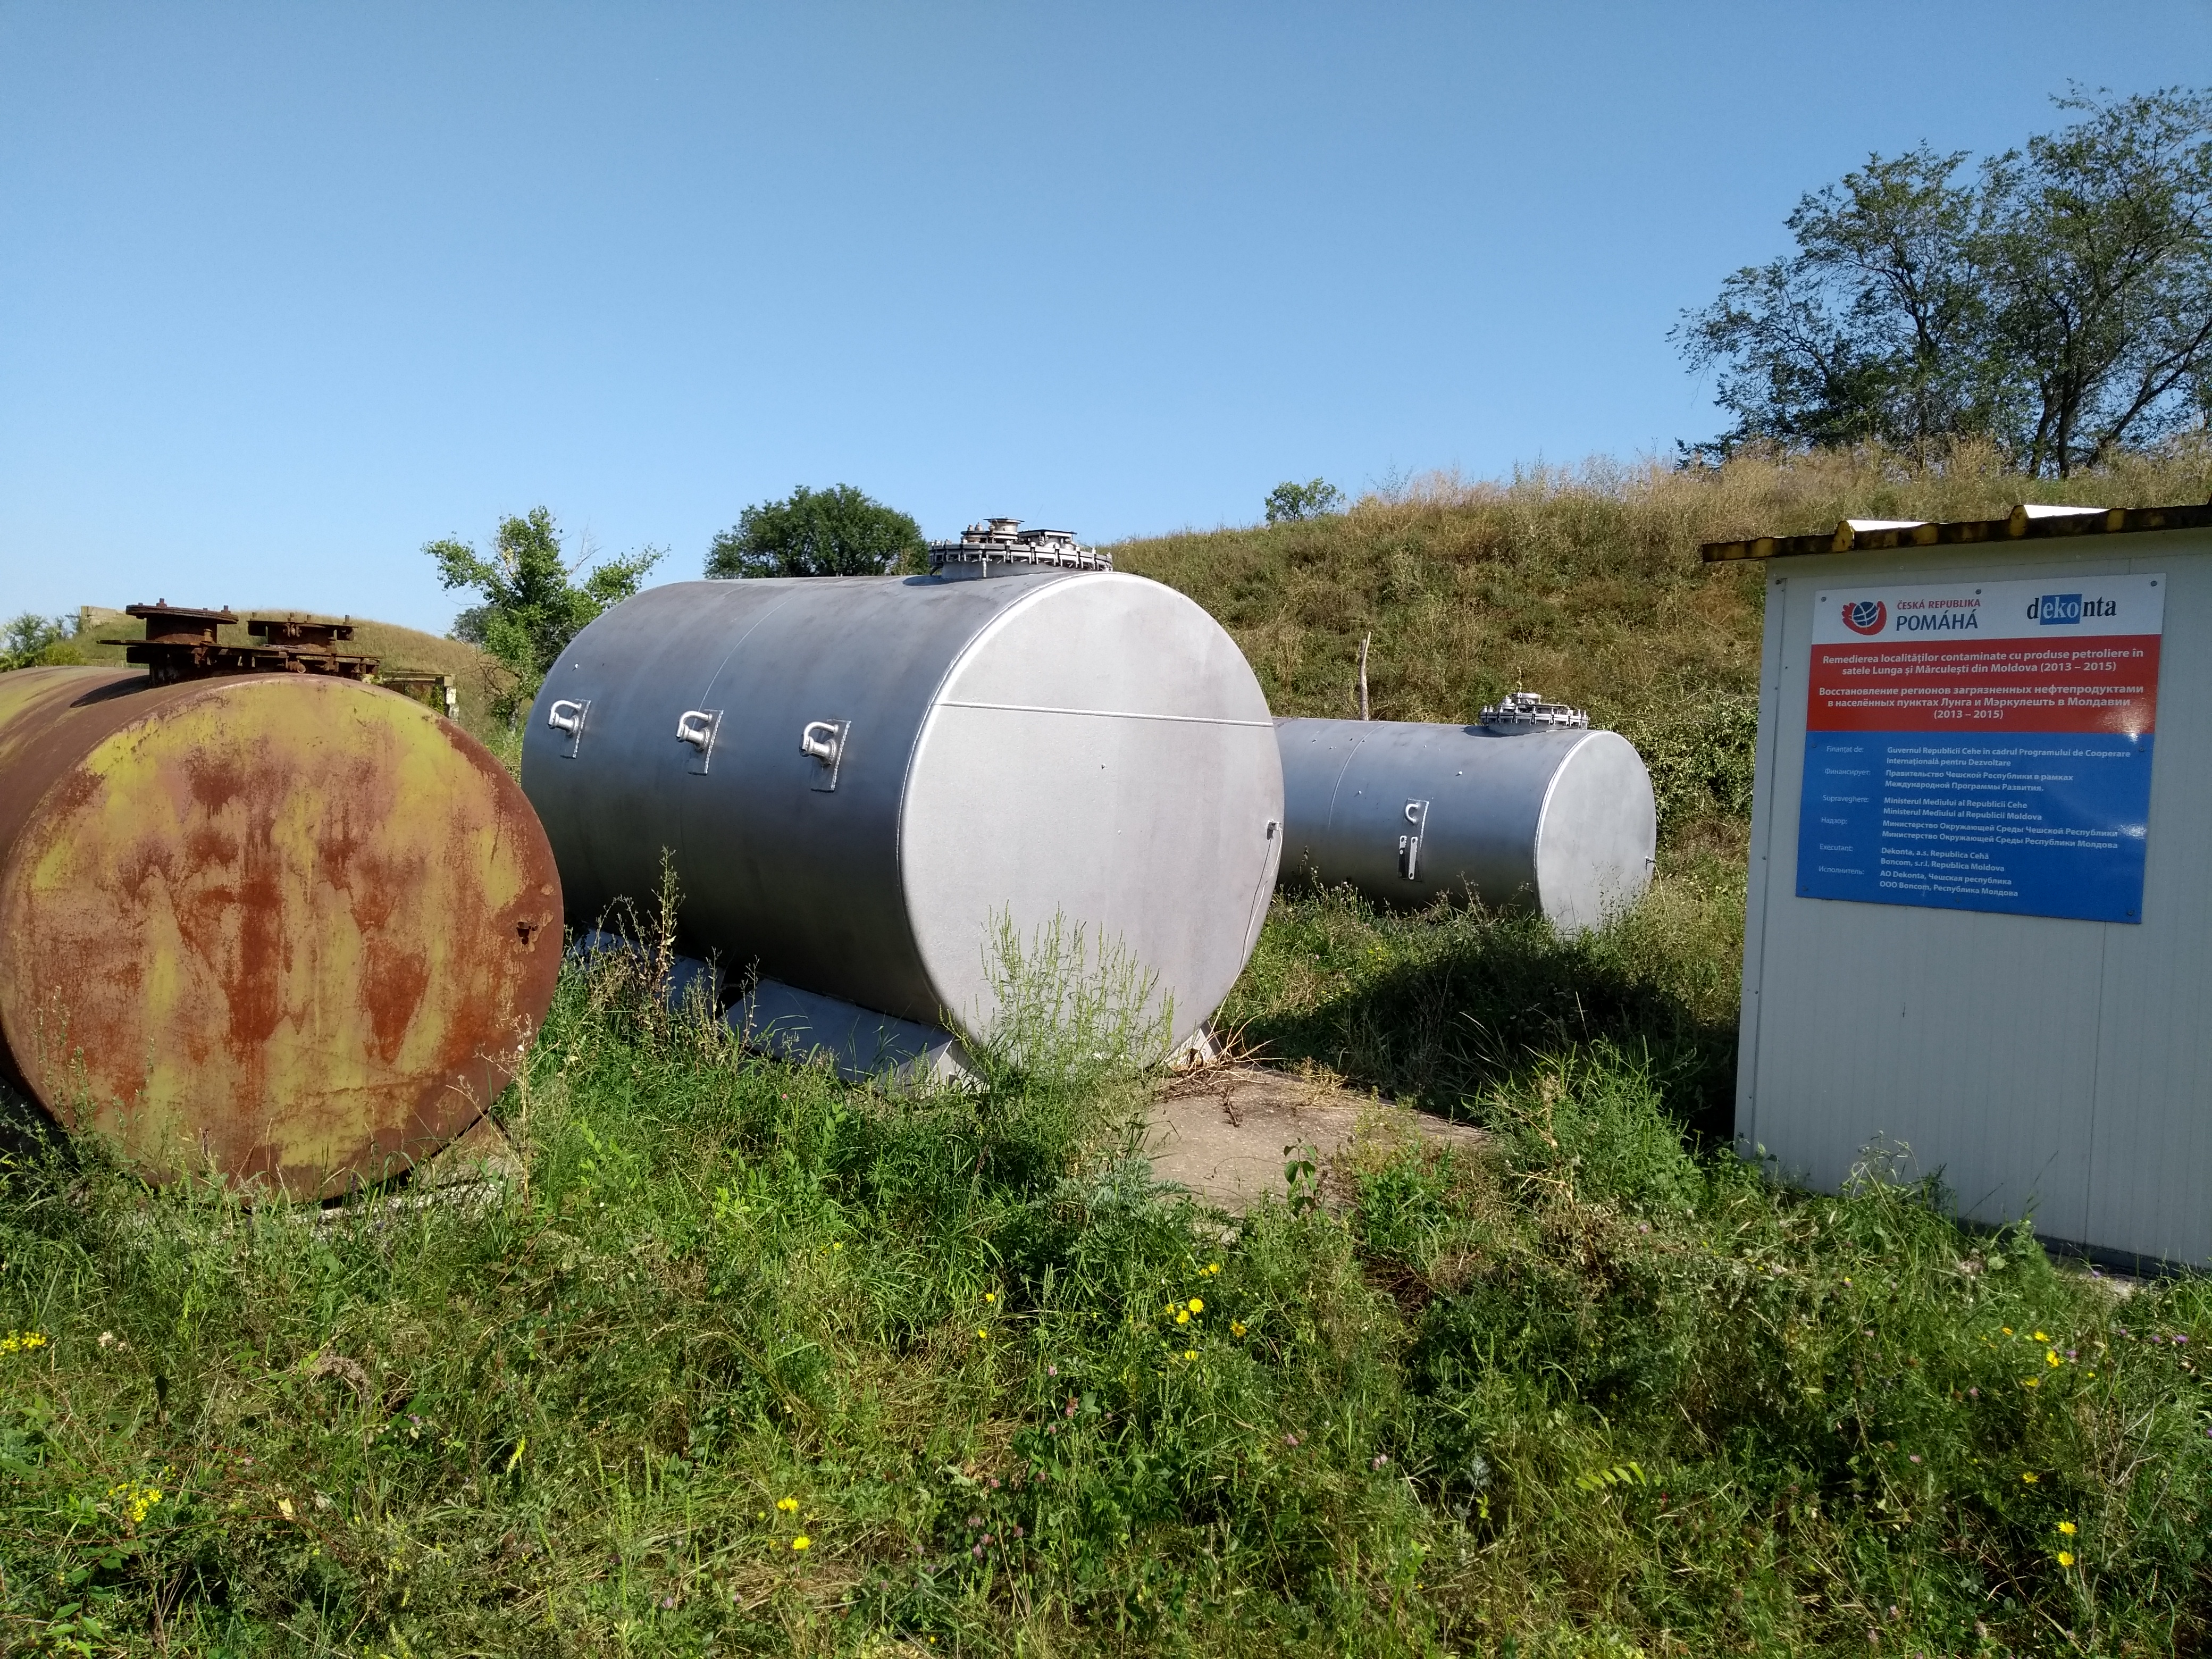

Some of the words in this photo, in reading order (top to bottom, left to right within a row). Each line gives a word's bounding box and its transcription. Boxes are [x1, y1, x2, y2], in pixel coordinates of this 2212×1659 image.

[1897, 599, 1925, 610] ČESKÁ
[1928, 599, 1981, 609] REPUBLIKA
[2026, 596, 2117, 620] dekonta
[1896, 609, 1979, 632] POMÁHÁ
[1823, 655, 1879, 664] Remedierea
[1941, 651, 2007, 661] contaminate
[2024, 650, 2069, 661] produse
[2072, 649, 2130, 660] petroliere
[2132, 648, 2144, 658] în
[1842, 666, 1871, 675] satele
[1872, 667, 1903, 676] Lunga
[1971, 663, 1989, 673] din
[1991, 663, 2038, 673] Moldova
[2040, 663, 2072, 673] (2013
[2083, 661, 2117, 672] 2015)
[1901, 688, 1951, 696] регионов
[1953, 686, 2032, 696] загрязненных
[2034, 684, 2144, 696] нефтепродуктами
[1836, 698, 1895, 707] населённых
[1897, 700, 1938, 708] пунктах
[1940, 698, 1972, 708] Лунга
[1984, 697, 2055, 708] Мэркулешть
[2067, 697, 2131, 708] Молдавии
[1934, 709, 1963, 719] (2013
[1973, 709, 2004, 719] 2015)
[1922, 747, 1960, 755] Republicii
[2085, 750, 2131, 758] Cooperare
[1824, 768, 1871, 776] Финансирует:
[1886, 769, 1944, 778] Правительство
[1983, 772, 2032, 781] Республики
[1885, 780, 1950, 789] Международной
[1951, 782, 2000, 791] Программы
[2002, 783, 2044, 792] Развития.
[1823, 794, 1869, 803] Supraveghere:
[1966, 800, 2006, 808] Republicii
[1966, 811, 2005, 819] Republicii
[1882, 820, 1938, 829] Министерство
[1939, 823, 1995, 832] Окружающей
[2025, 826, 2064, 835] Чешской
[2065, 828, 2118, 837] Республики
[1882, 831, 1938, 840] Министерство
[1939, 833, 1994, 843] Окружающей
[2025, 837, 2075, 847] Республики
[2077, 840, 2118, 849] Молдова
[1881, 847, 1914, 856] Dekonta,
[1930, 850, 1968, 859] Republica
[1819, 866, 1865, 875] Исполнитель:
[1881, 858, 1913, 866] Boncom,
[1931, 861, 1969, 869] Republica
[1971, 863, 2005, 872] Moldova
[1892, 870, 1927, 880] Dekonta,
[1929, 873, 1963, 882] Чешская
[1899, 882, 1932, 891] Boncom,
[1933, 884, 1980, 894] Республика
[1981, 887, 2018, 896] Молдова
